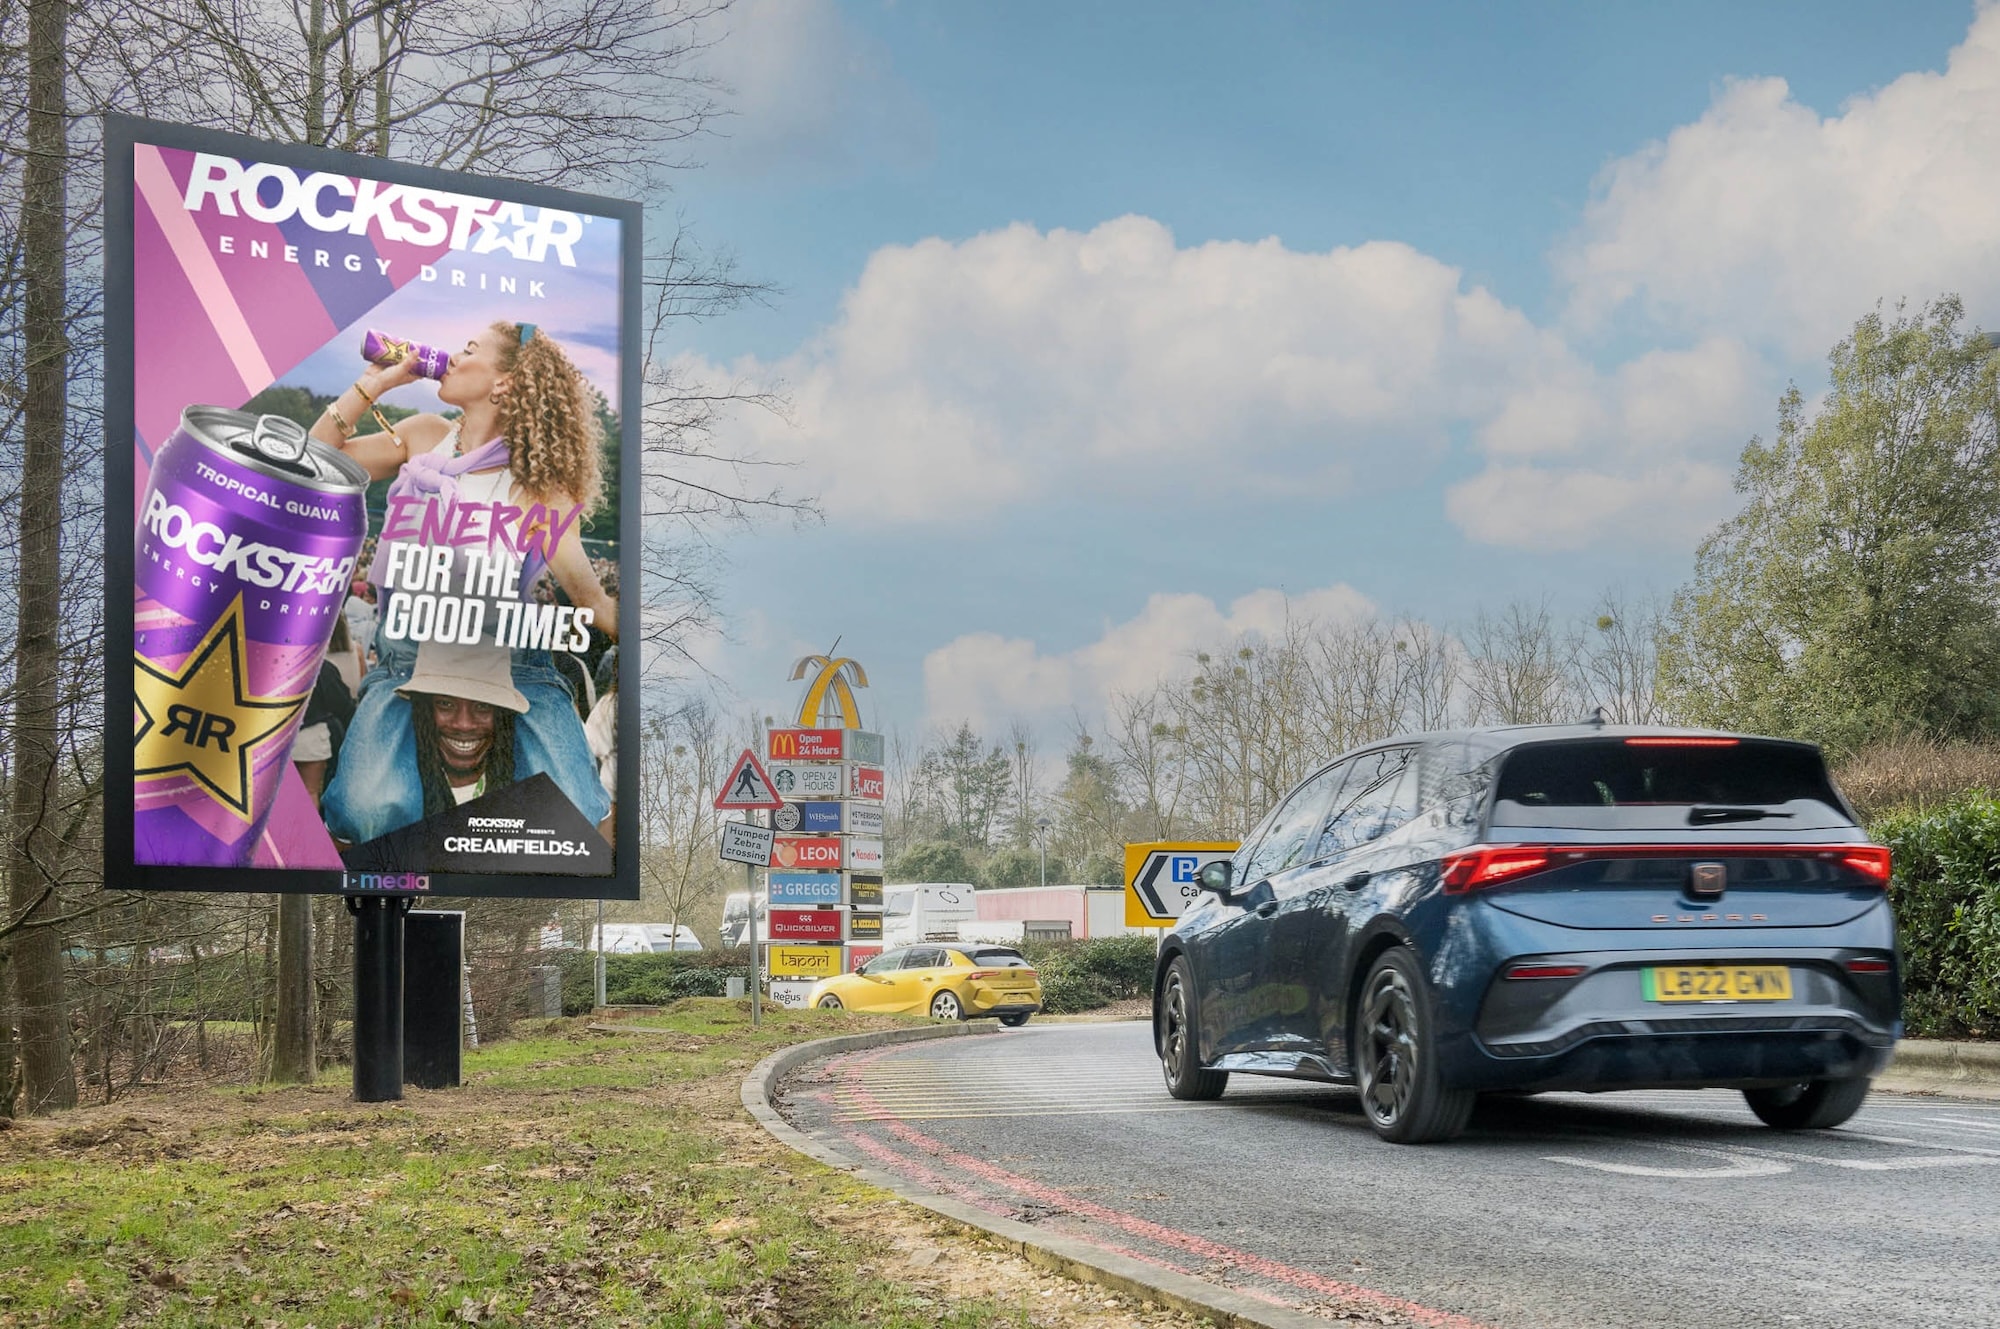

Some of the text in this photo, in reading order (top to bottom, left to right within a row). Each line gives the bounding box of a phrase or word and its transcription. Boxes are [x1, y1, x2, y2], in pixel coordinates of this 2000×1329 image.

[184, 152, 578, 267] ROCKSTAR
[219, 236, 545, 298] ENERGY DRINK
[196, 462, 340, 521] TROPICAL GUAVA
[381, 493, 584, 561] ENERGY
[143, 488, 354, 595] ROCKSTAR
[384, 541, 524, 599] FOR THE
[143, 544, 330, 615] ENERGY DRINK
[385, 592, 594, 653] GOOD TIMES
[799, 734, 822, 745] Open
[799, 746, 839, 755] 24 Hours
[802, 771, 837, 780] OPEN 24
[805, 781, 835, 791] HOURS
[863, 779, 882, 794] KFC
[468, 817, 526, 829] ROCKSTAR
[809, 813, 838, 821] WHSmith
[730, 826, 770, 841] Humped
[443, 837, 574, 856] CREAMFIELDS
[734, 837, 761, 849] Zebra
[726, 847, 766, 861] crossing
[800, 847, 838, 860] LEON
[1178, 859, 1195, 881] P
[785, 883, 838, 896] GREGGS
[773, 991, 801, 1004] Regus
